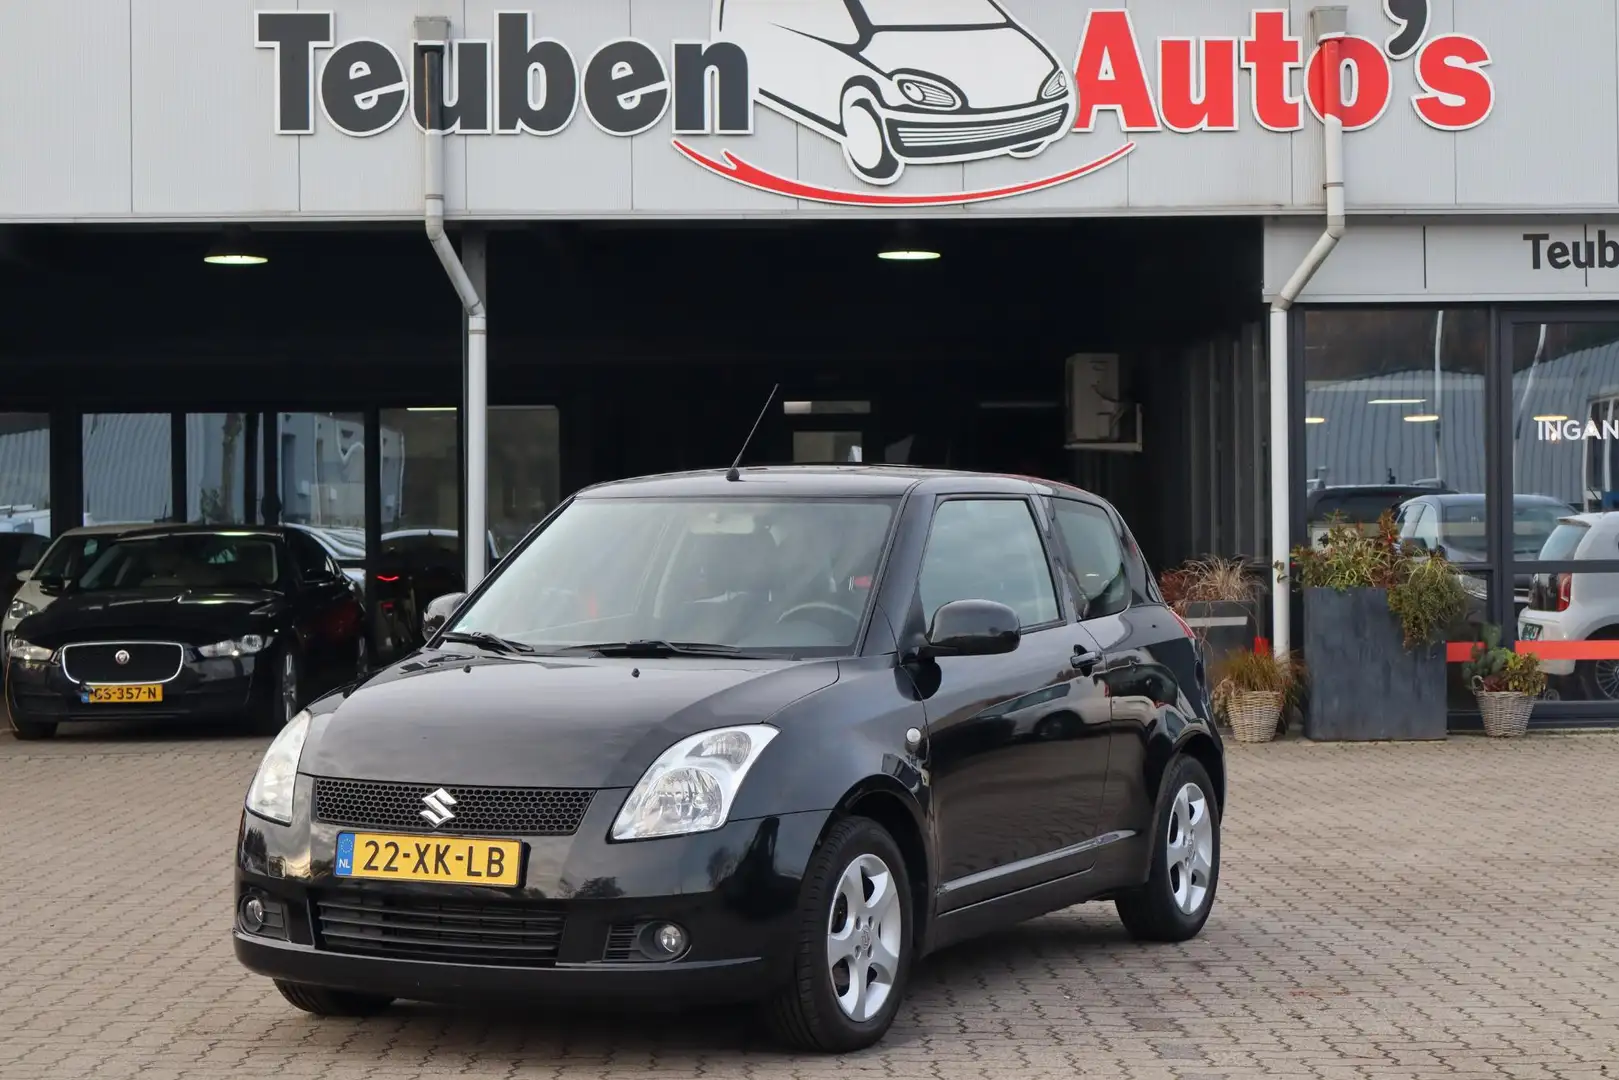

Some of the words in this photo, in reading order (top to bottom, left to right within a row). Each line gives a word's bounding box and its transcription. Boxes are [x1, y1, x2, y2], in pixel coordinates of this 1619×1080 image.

[256, 10, 753, 135] Teuben
[1073, 0, 1495, 132] Auto's
[1522, 229, 1619, 270] Teub
[1537, 418, 1619, 440] INGAN
[338, 858, 351, 869] NL
[363, 840, 505, 878] 22-XK-LB
